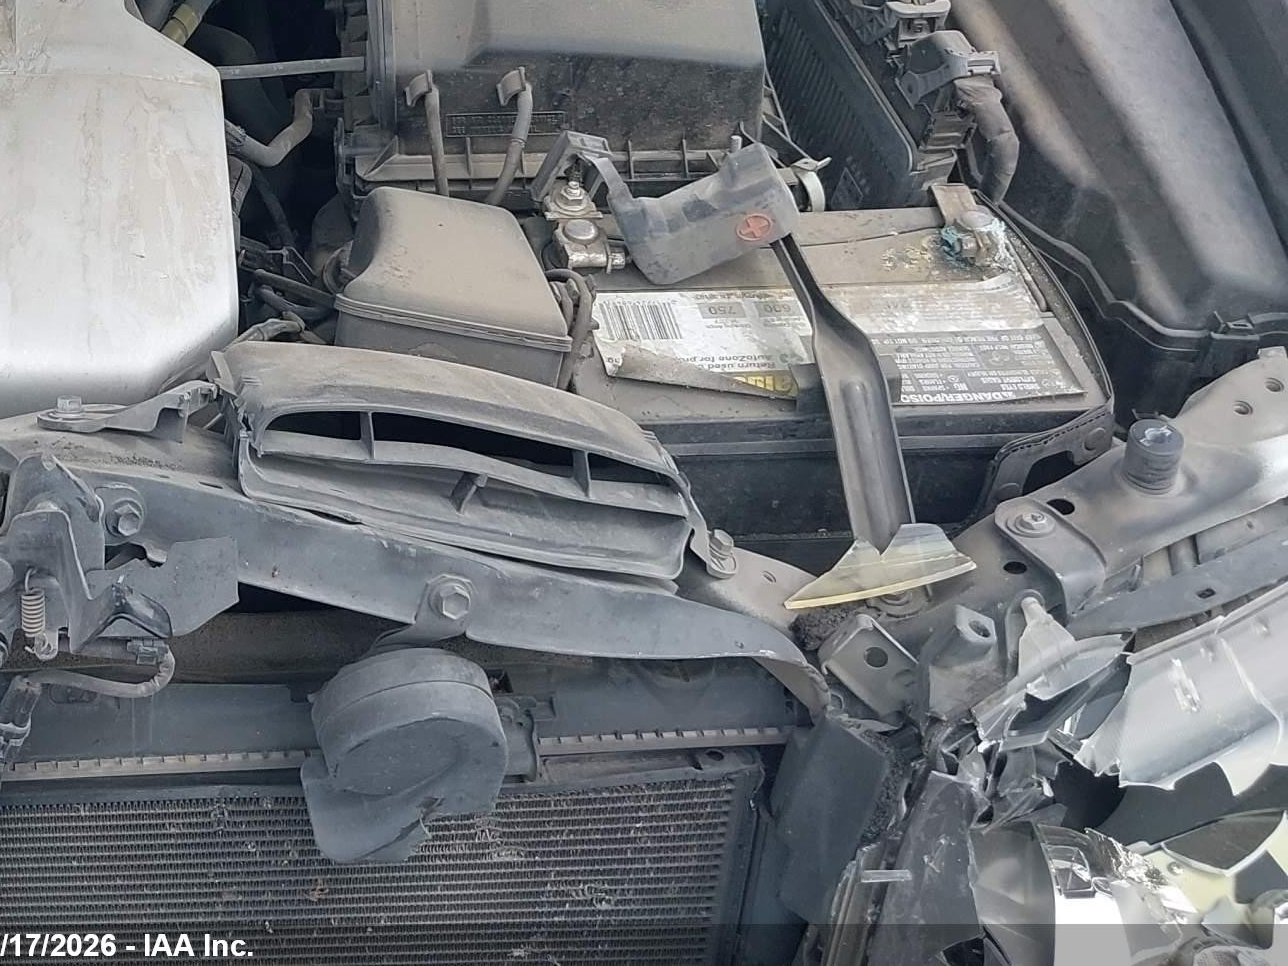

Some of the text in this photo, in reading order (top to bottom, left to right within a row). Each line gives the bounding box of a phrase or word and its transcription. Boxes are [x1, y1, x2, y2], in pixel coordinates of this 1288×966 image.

[708, 305, 737, 315] 750
[737, 361, 776, 369] Return
[901, 391, 1003, 403] DANGER/POISO
